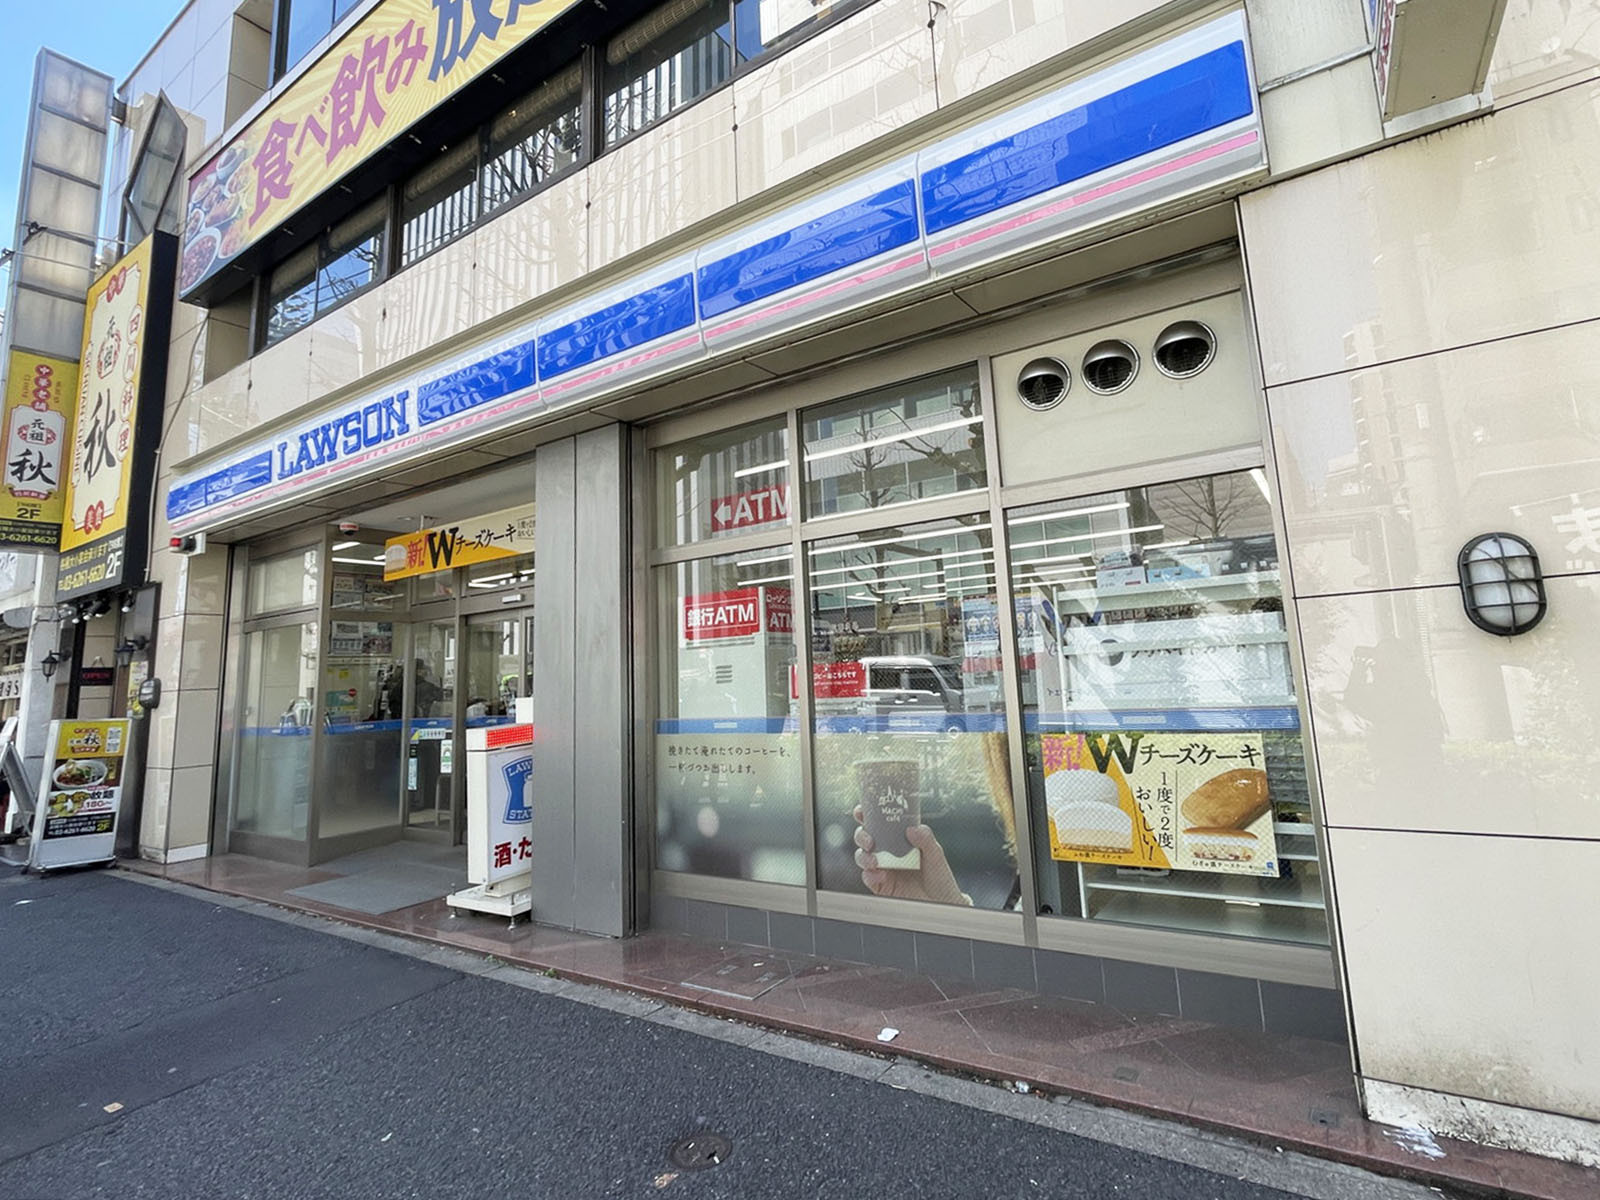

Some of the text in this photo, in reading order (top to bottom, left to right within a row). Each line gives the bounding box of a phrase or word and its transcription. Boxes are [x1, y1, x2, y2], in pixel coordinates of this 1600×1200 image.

[249, 0, 545, 230] 食べ飲み放
[83, 388, 116, 484] 秋
[277, 389, 409, 480] LAWSON
[8, 448, 56, 485] 秋
[17, 508, 41, 519] 2F
[732, 486, 792, 525] ATM
[105, 551, 123, 579] 2F
[687, 603, 754, 628] 銀行ATM
[1136, 786, 1158, 861] おいしい!
[1157, 772, 1174, 850] 1度で2度
